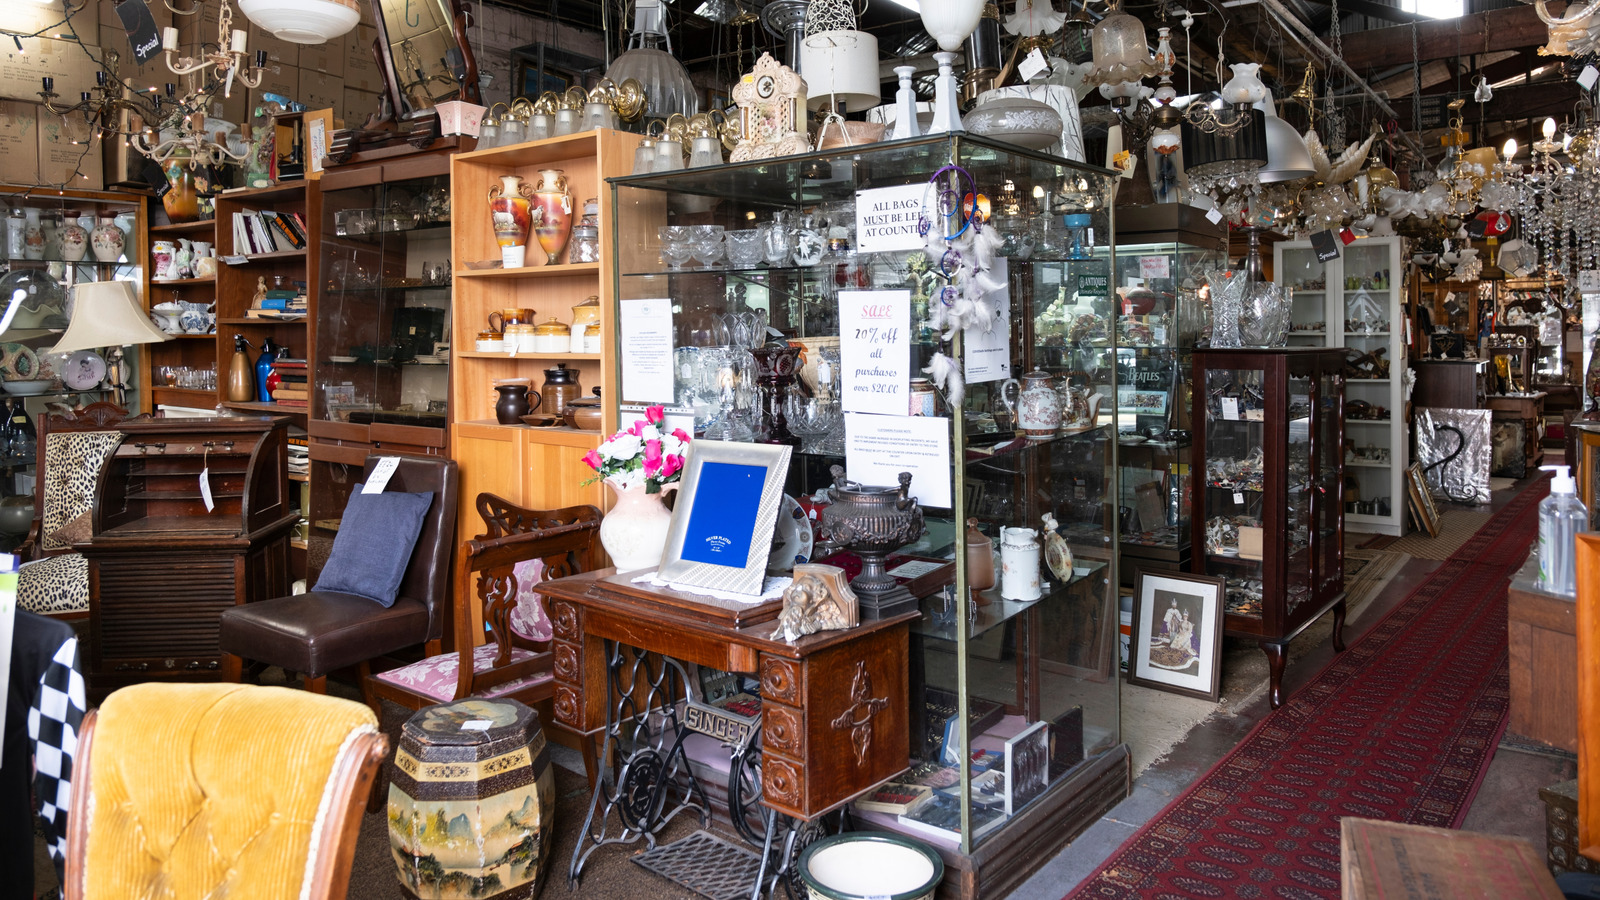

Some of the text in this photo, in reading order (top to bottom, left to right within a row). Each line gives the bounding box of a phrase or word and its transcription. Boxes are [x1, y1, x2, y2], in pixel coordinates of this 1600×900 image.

[136, 33, 159, 58] Special
[156, 180, 169, 197] Special
[872, 199, 919, 212] ALL BAGS
[863, 214, 889, 226] MUST
[891, 212, 904, 223] BE
[864, 228, 877, 238] AT
[1319, 248, 1337, 260] Special
[1085, 276, 1107, 288] ANTIQUES
[861, 304, 893, 319] SALE
[881, 327, 898, 344] off
[869, 348, 883, 359] all
[855, 365, 897, 378] purchases
[1128, 367, 1160, 384] BEATLES
[853, 383, 899, 394] over $20.00
[688, 707, 749, 743] SINGER
